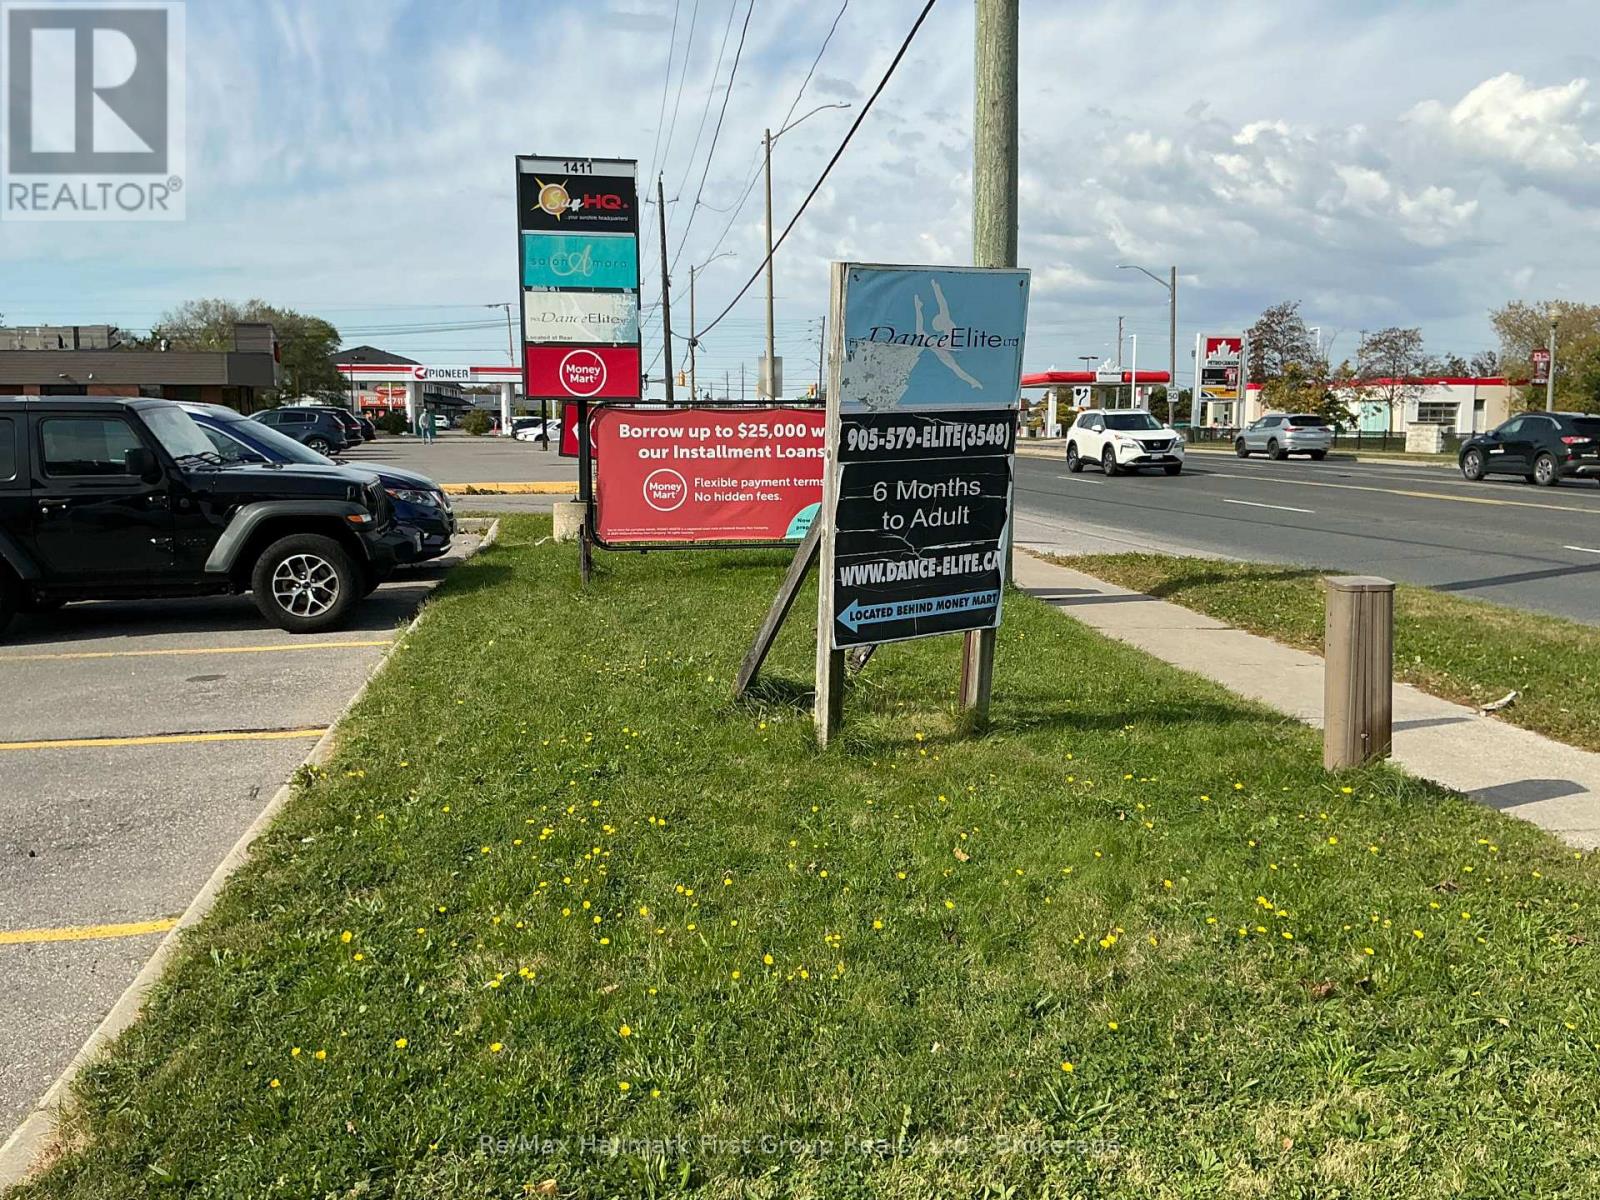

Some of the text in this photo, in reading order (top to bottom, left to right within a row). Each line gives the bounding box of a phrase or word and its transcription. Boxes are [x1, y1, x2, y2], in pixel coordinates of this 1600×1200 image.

[563, 162, 593, 174] 1411
[429, 369, 469, 379] PIONEER
[566, 364, 601, 376] Money
[619, 423, 684, 438] Borrow
[688, 425, 711, 441] up
[715, 425, 734, 438] to
[737, 422, 807, 440] $25,000
[638, 445, 825, 459] our Installment Loans
[649, 482, 681, 493] Money
[694, 477, 738, 488] Flexible
[741, 479, 791, 490] payment
[872, 477, 981, 501] 6 Months
[694, 491, 782, 502] No hidden fees.
[882, 506, 970, 530] to Adult
[849, 593, 998, 622] LOCATED BEHIND MONEY MART
